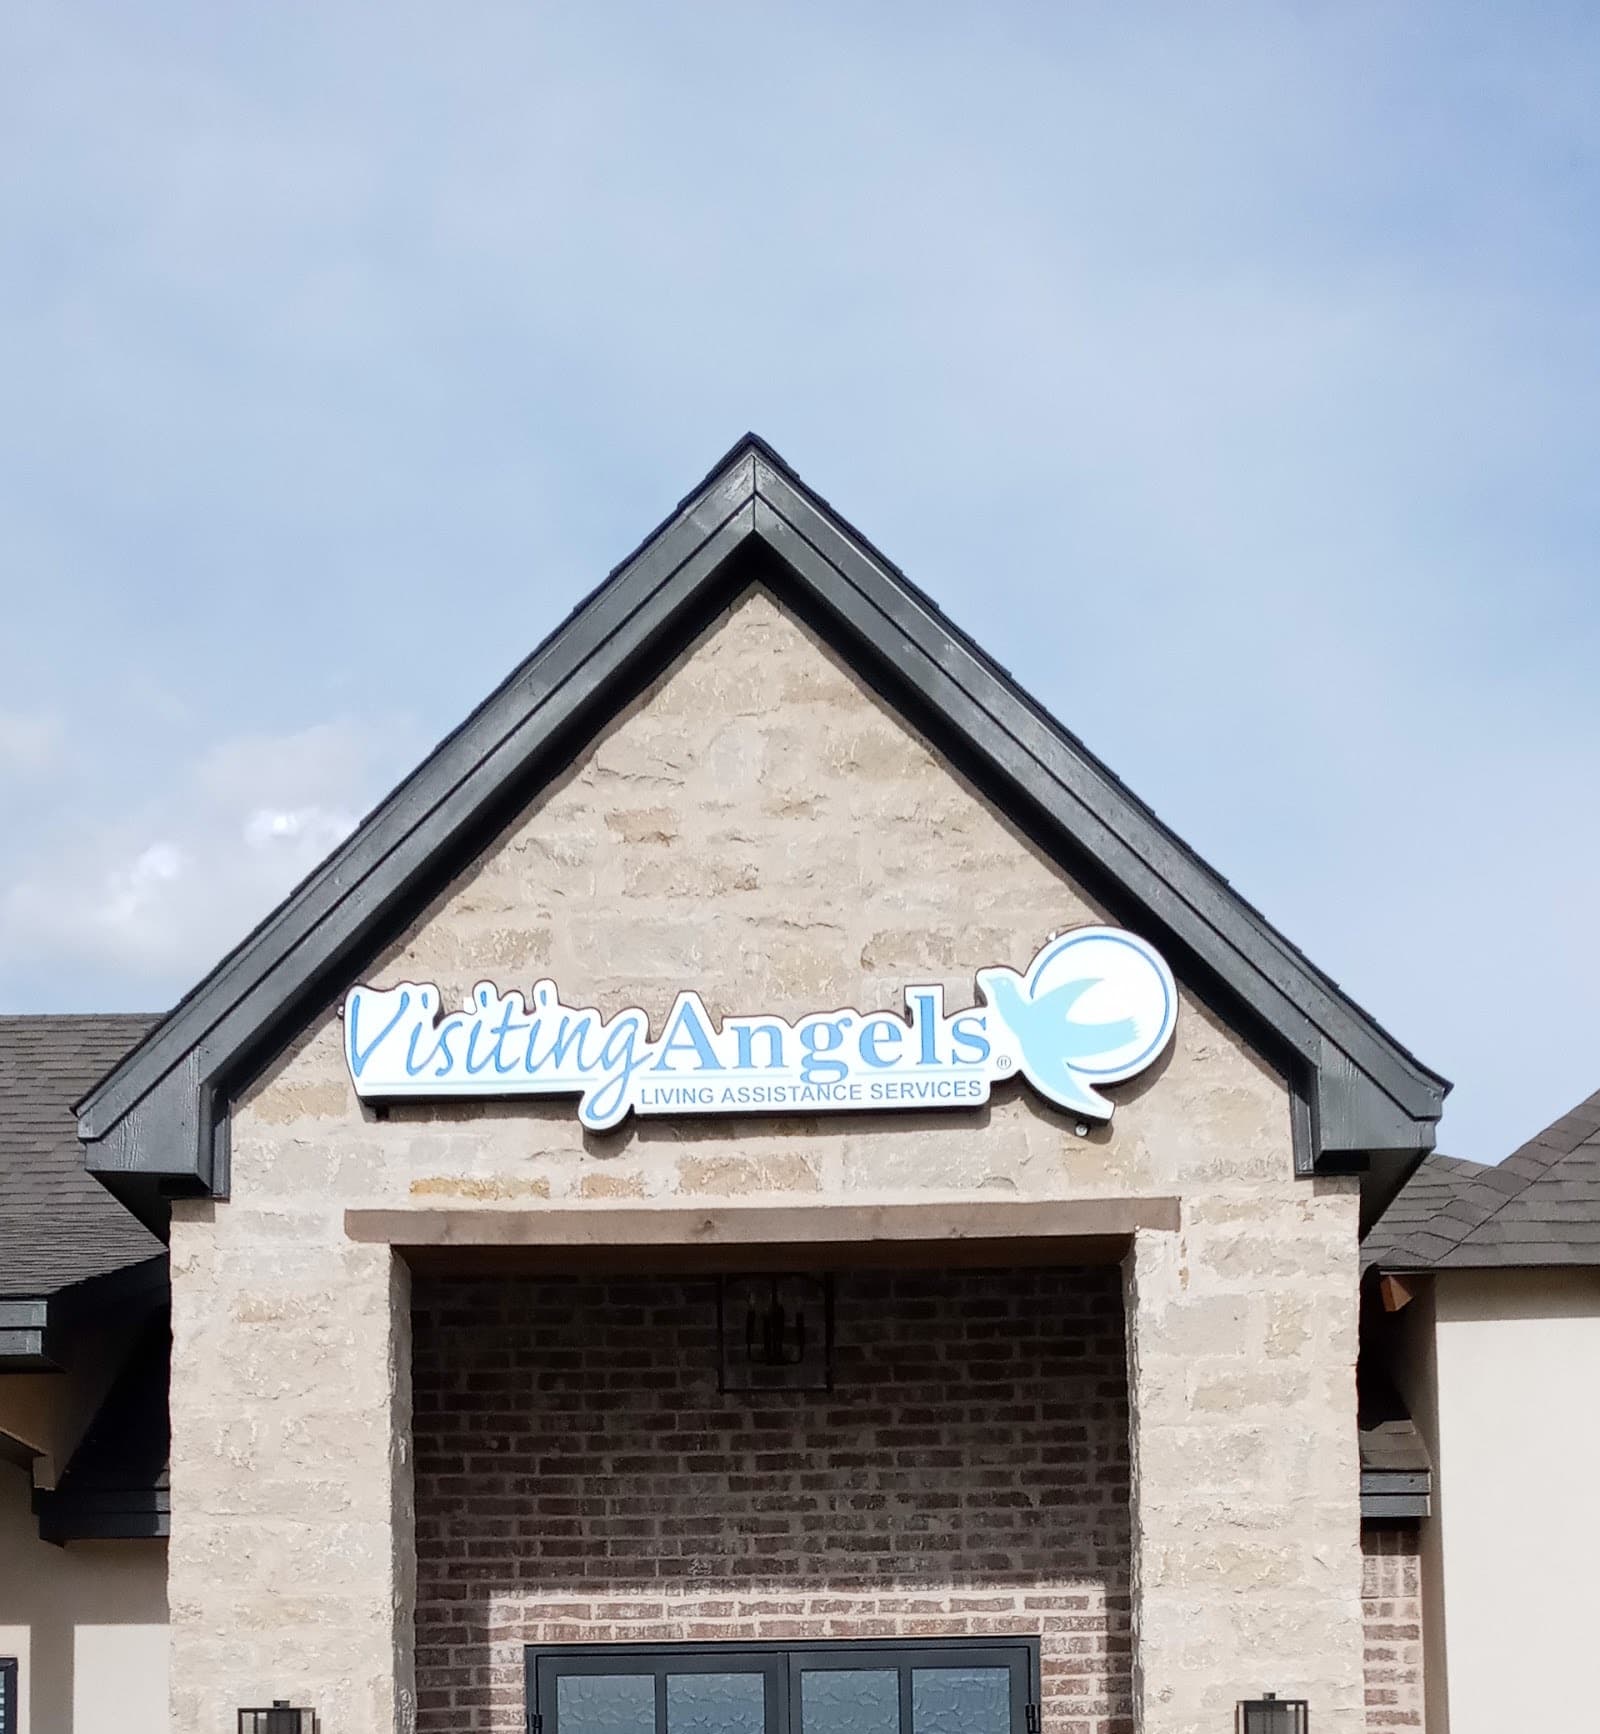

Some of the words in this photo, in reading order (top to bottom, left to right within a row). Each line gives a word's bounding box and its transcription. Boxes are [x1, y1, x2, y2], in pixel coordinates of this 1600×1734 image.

[350, 989, 653, 1120] Visiting
[649, 995, 991, 1085] Angels
[641, 1087, 714, 1105] LIVING
[720, 1083, 862, 1104] ASSISTANCE
[870, 1080, 982, 1100] SERVICES
